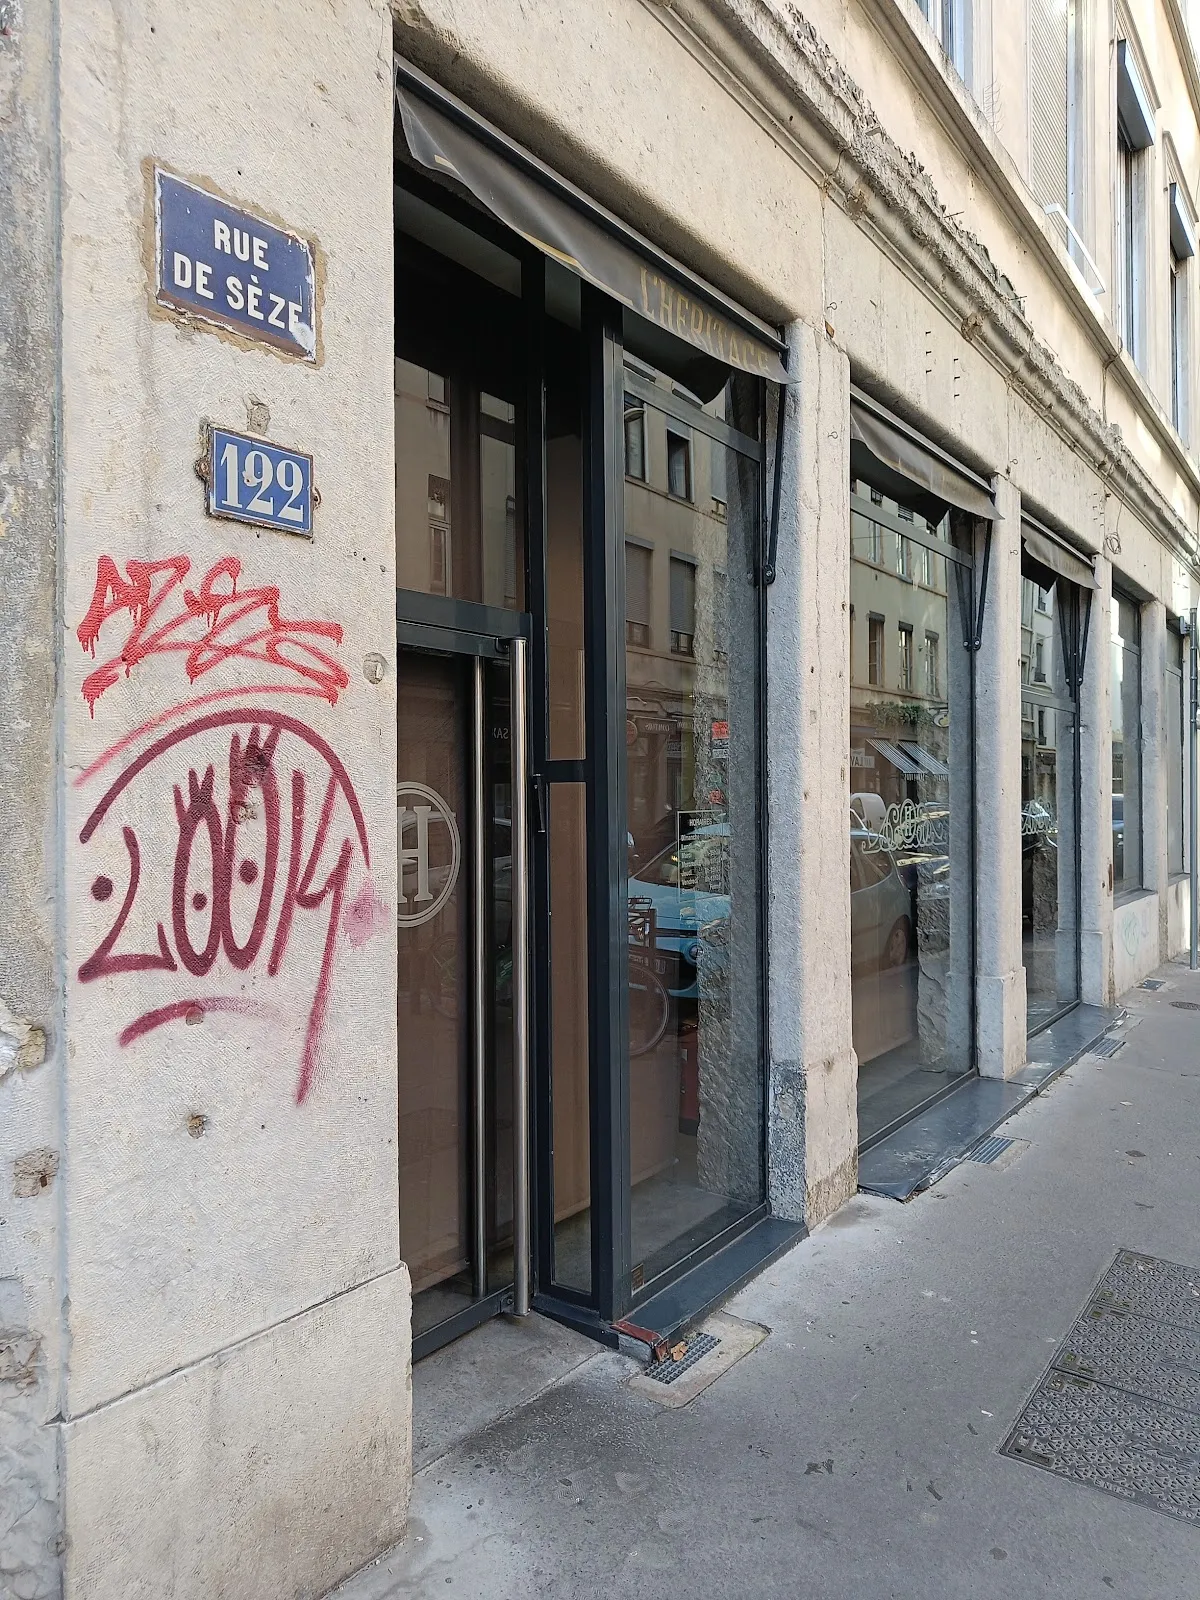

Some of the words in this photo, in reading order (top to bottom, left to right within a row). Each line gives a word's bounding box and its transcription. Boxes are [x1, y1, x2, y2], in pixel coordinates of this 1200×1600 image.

[214, 219, 269, 271] RUE
[174, 252, 214, 300] DE
[226, 274, 304, 333] SÈZE
[220, 442, 304, 523] 122
